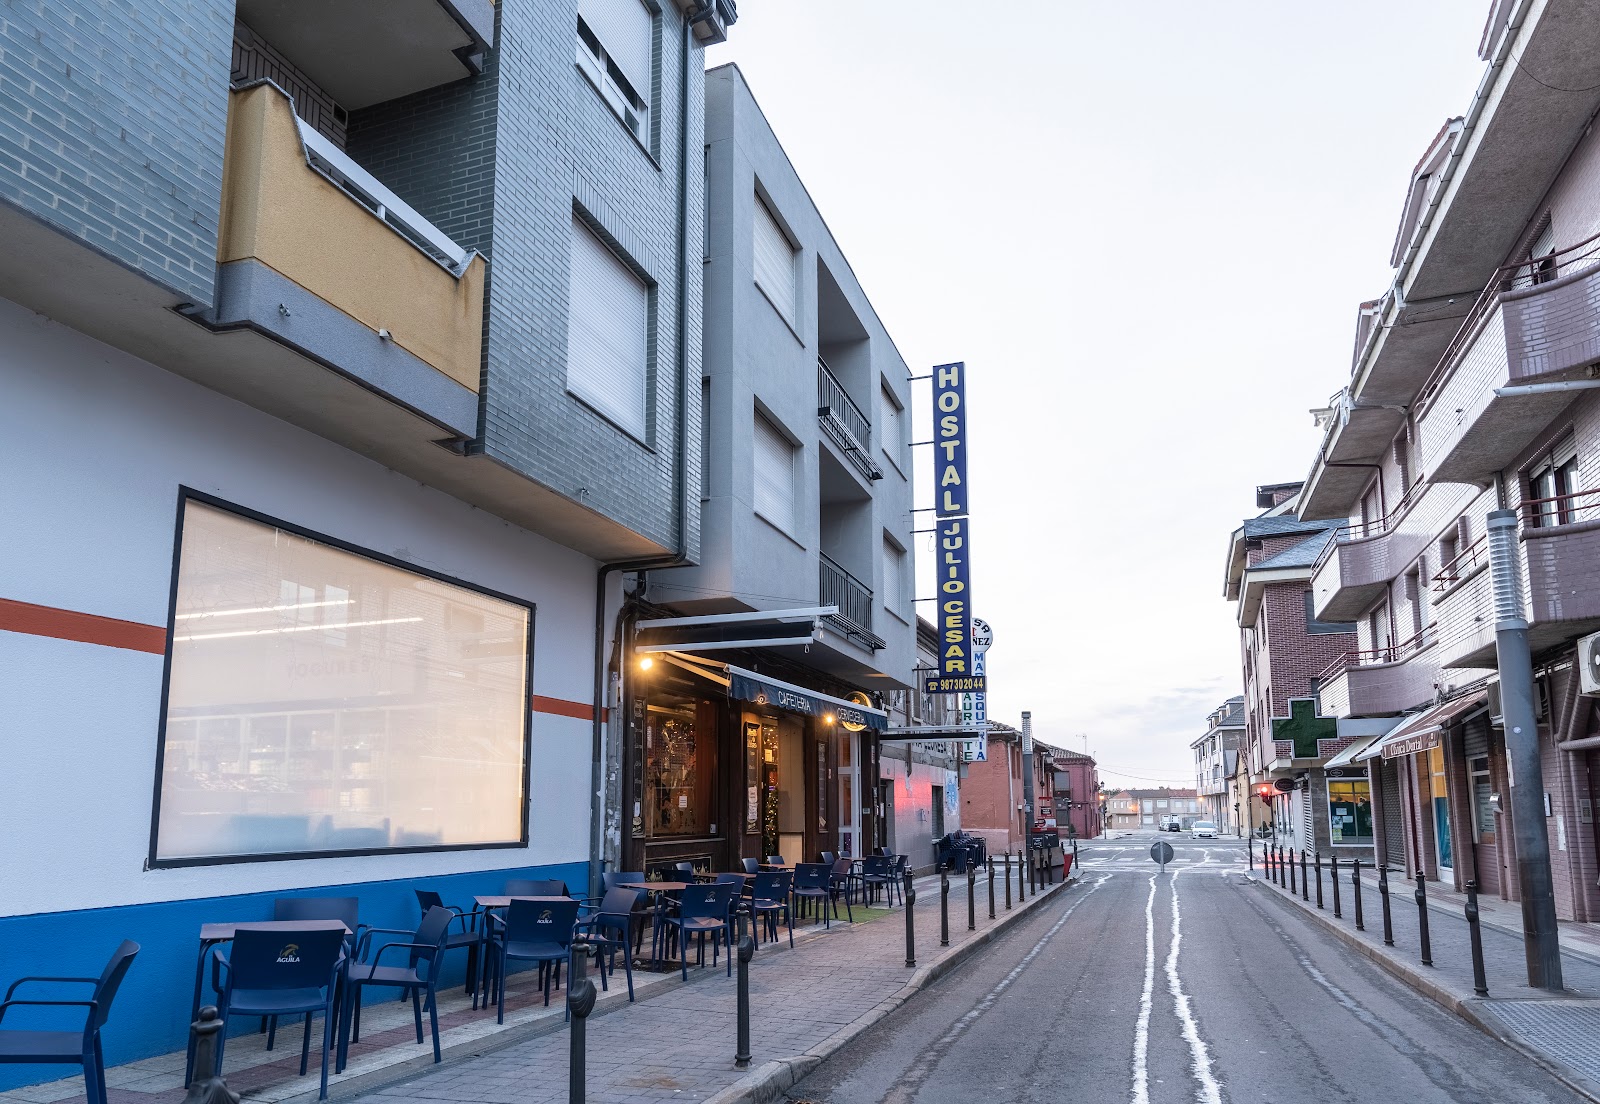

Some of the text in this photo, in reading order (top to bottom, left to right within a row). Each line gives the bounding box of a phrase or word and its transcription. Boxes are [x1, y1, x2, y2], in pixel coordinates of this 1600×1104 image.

[938, 366, 961, 511] HOSTAL
[942, 522, 966, 673] JULIO CESAR
[974, 619, 991, 634] SA
[972, 637, 990, 646] NEZ
[778, 691, 812, 712] CAFETERIA
